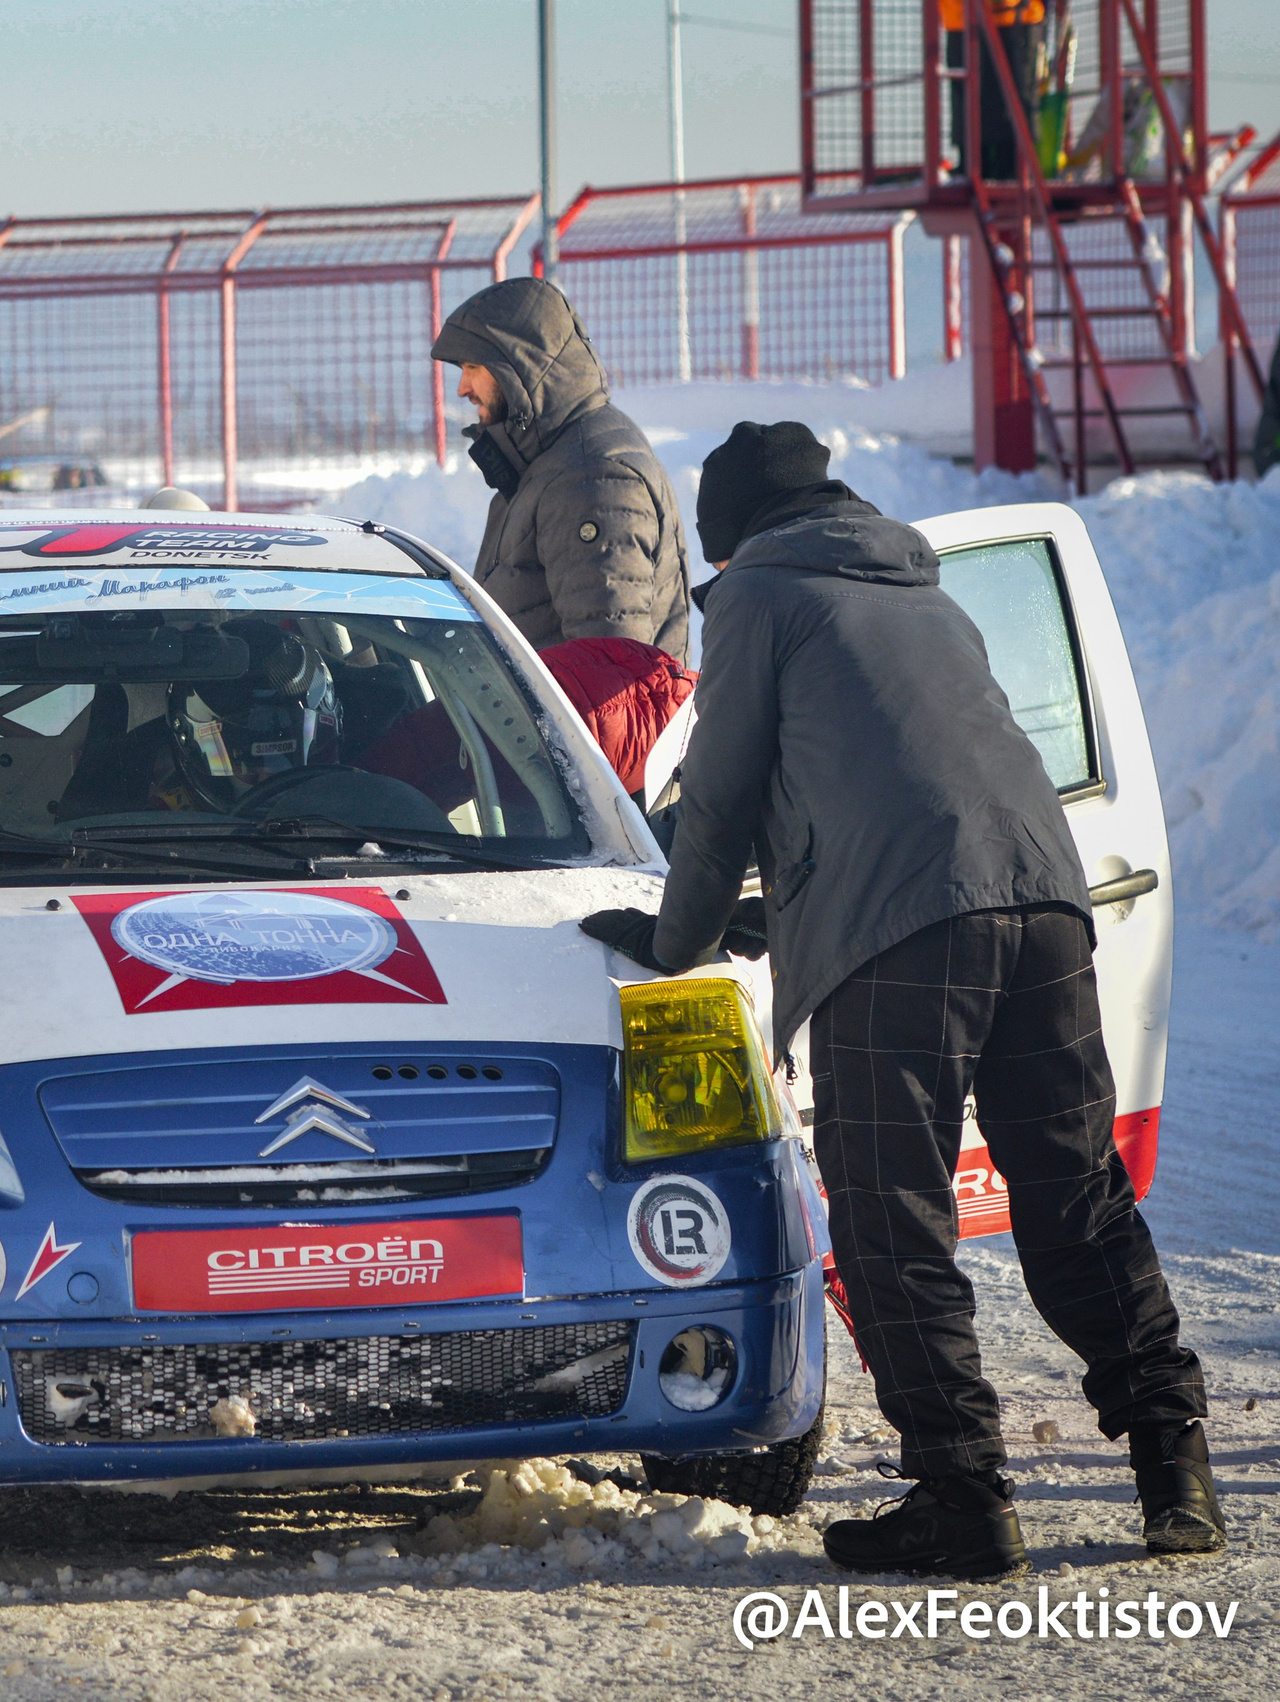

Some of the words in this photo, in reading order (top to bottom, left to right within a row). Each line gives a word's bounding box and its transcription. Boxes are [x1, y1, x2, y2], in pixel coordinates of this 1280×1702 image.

[135, 539, 257, 549] TEAM
[144, 531, 311, 543] RACING
[130, 551, 272, 560] DONETSK
[85, 575, 231, 606] Марафон
[143, 932, 241, 949] ОДНА
[250, 929, 366, 945] ТОННА
[358, 1266, 445, 1288] SPORT
